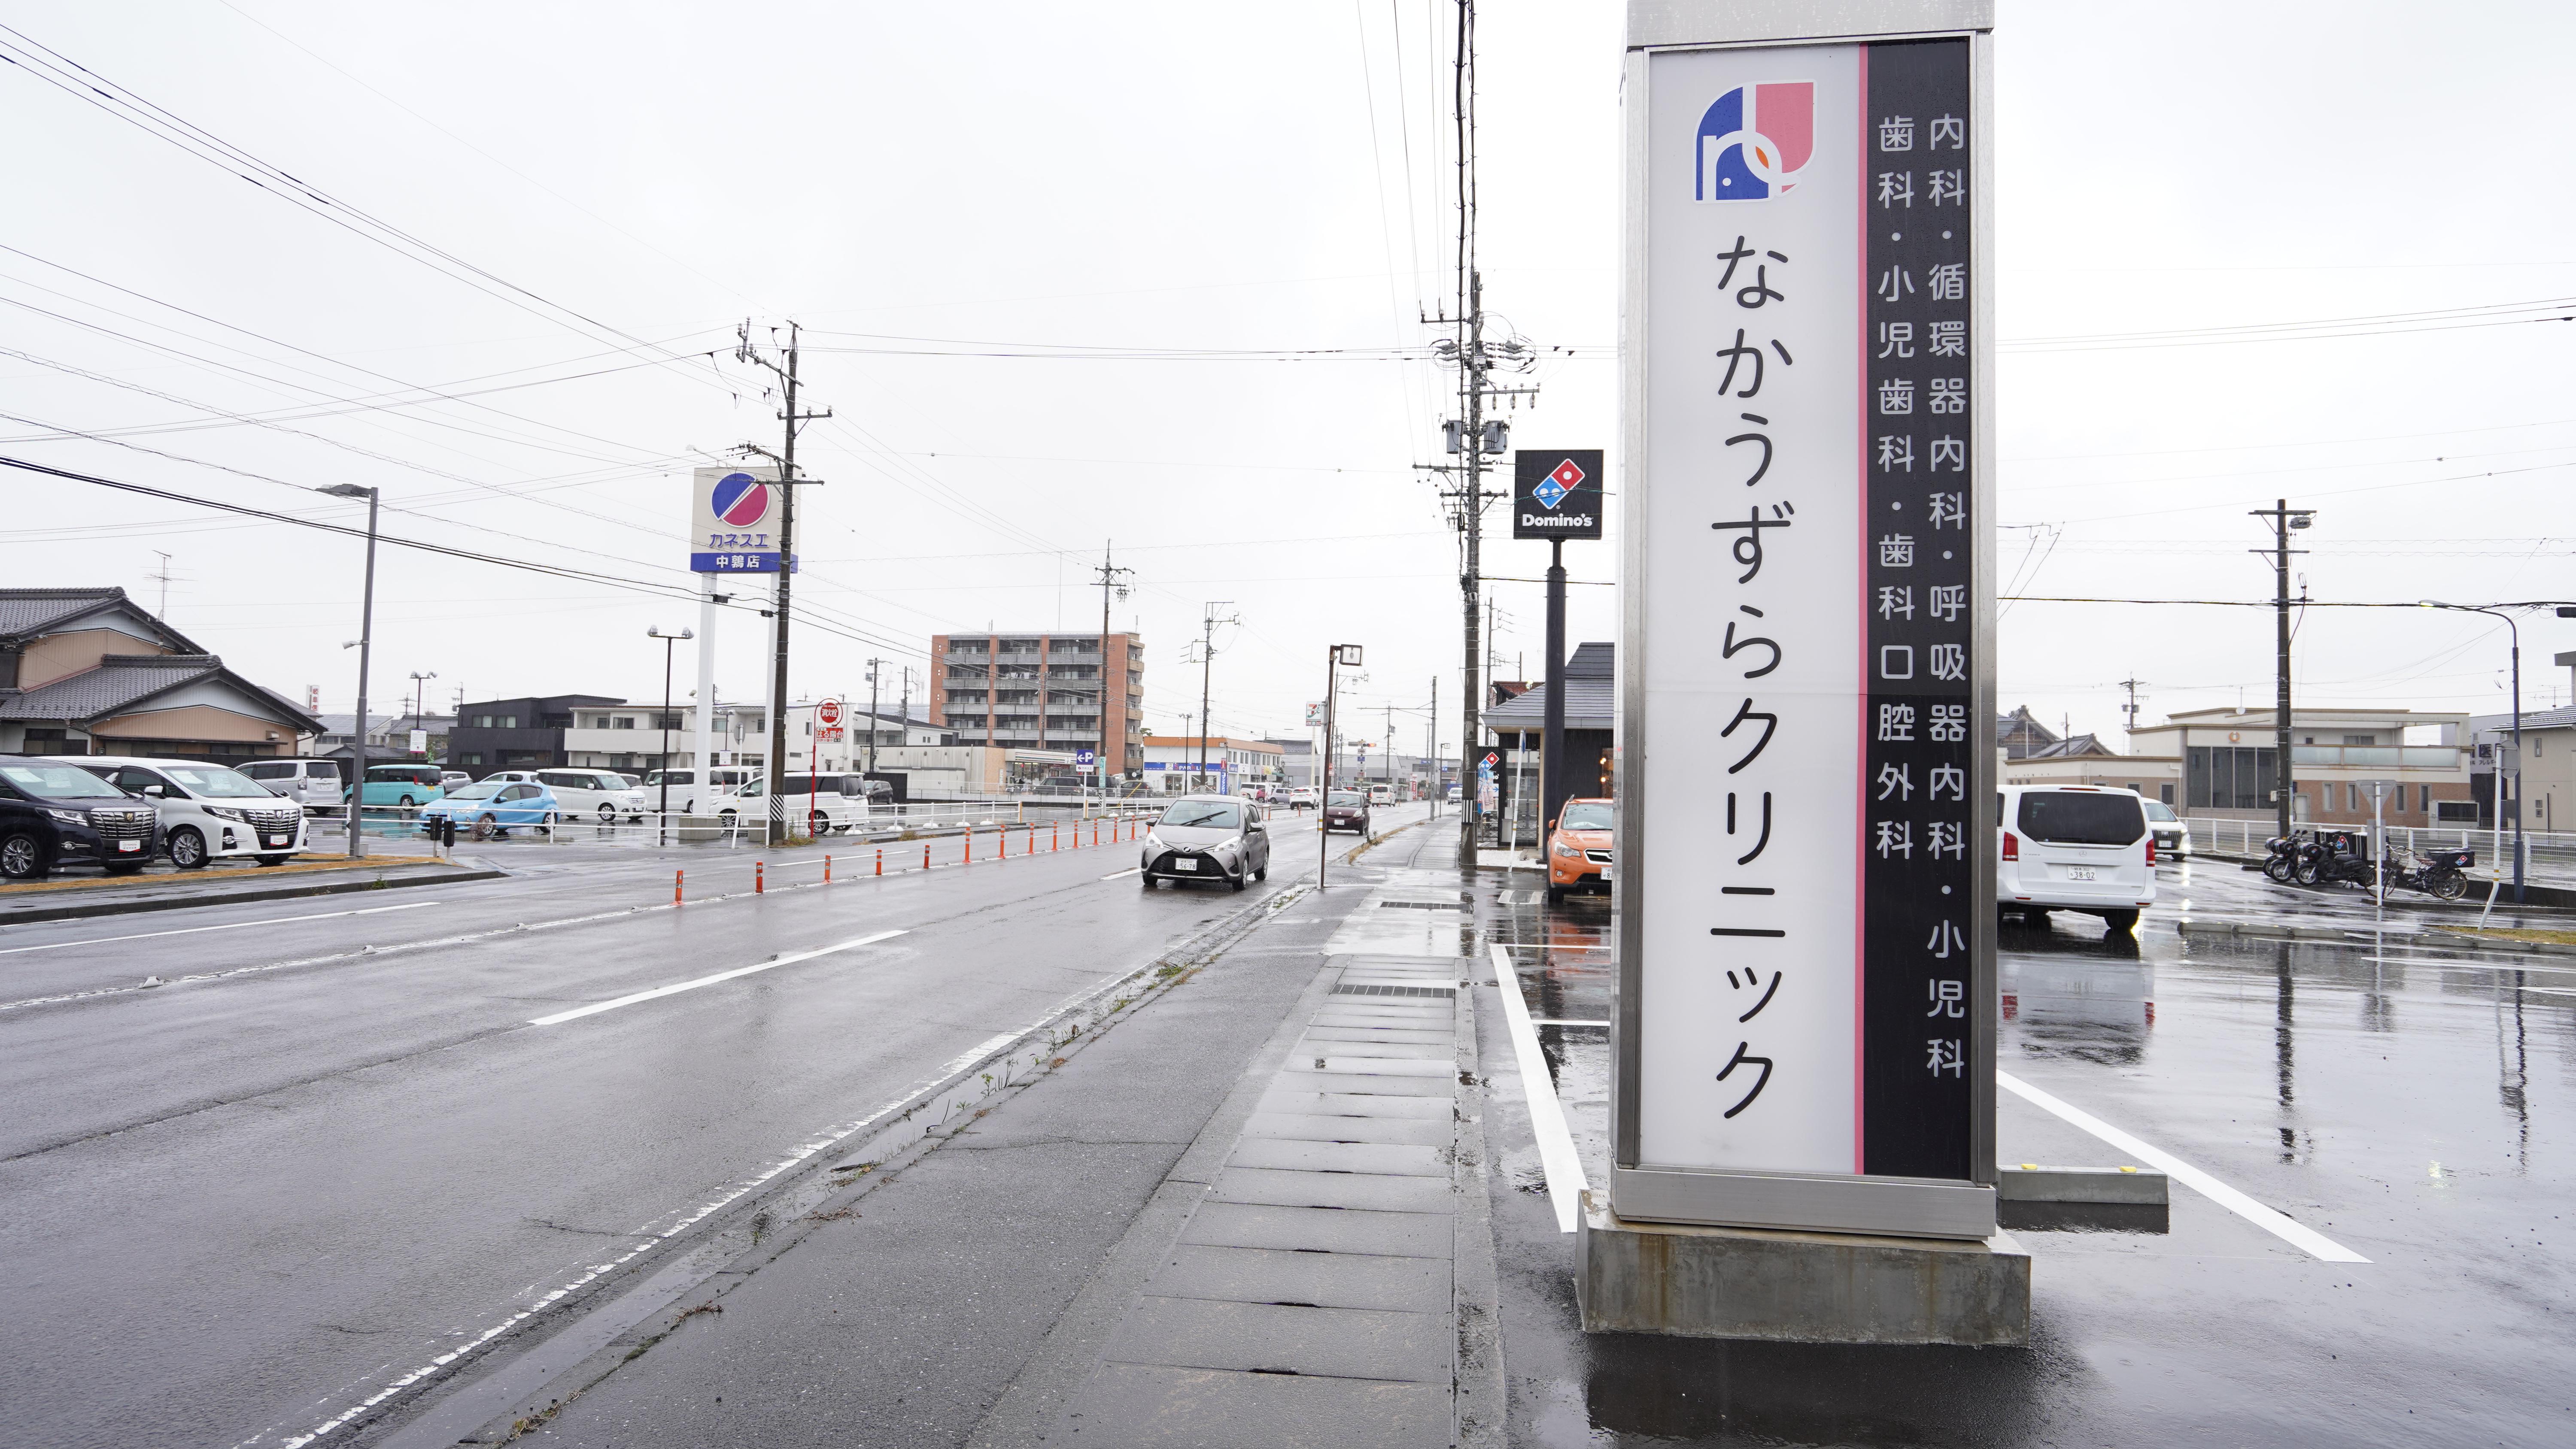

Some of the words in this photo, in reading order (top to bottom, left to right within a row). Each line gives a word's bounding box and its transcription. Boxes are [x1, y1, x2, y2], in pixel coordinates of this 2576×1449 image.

[1877, 115, 1915, 860] 歯科・小児歯科・歯科口腔外科
[1522, 513, 1593, 527] Domino's
[709, 534, 769, 548] カネスエ
[716, 555, 760, 568] 中鶉店
[1927, 113, 1966, 1079] 内科・循環器内科・呼吸器内科・小児科
[1710, 235, 1795, 1119] なかうずらクリニック
[822, 709, 838, 717] 消火栓
[1085, 752, 1093, 762] P
